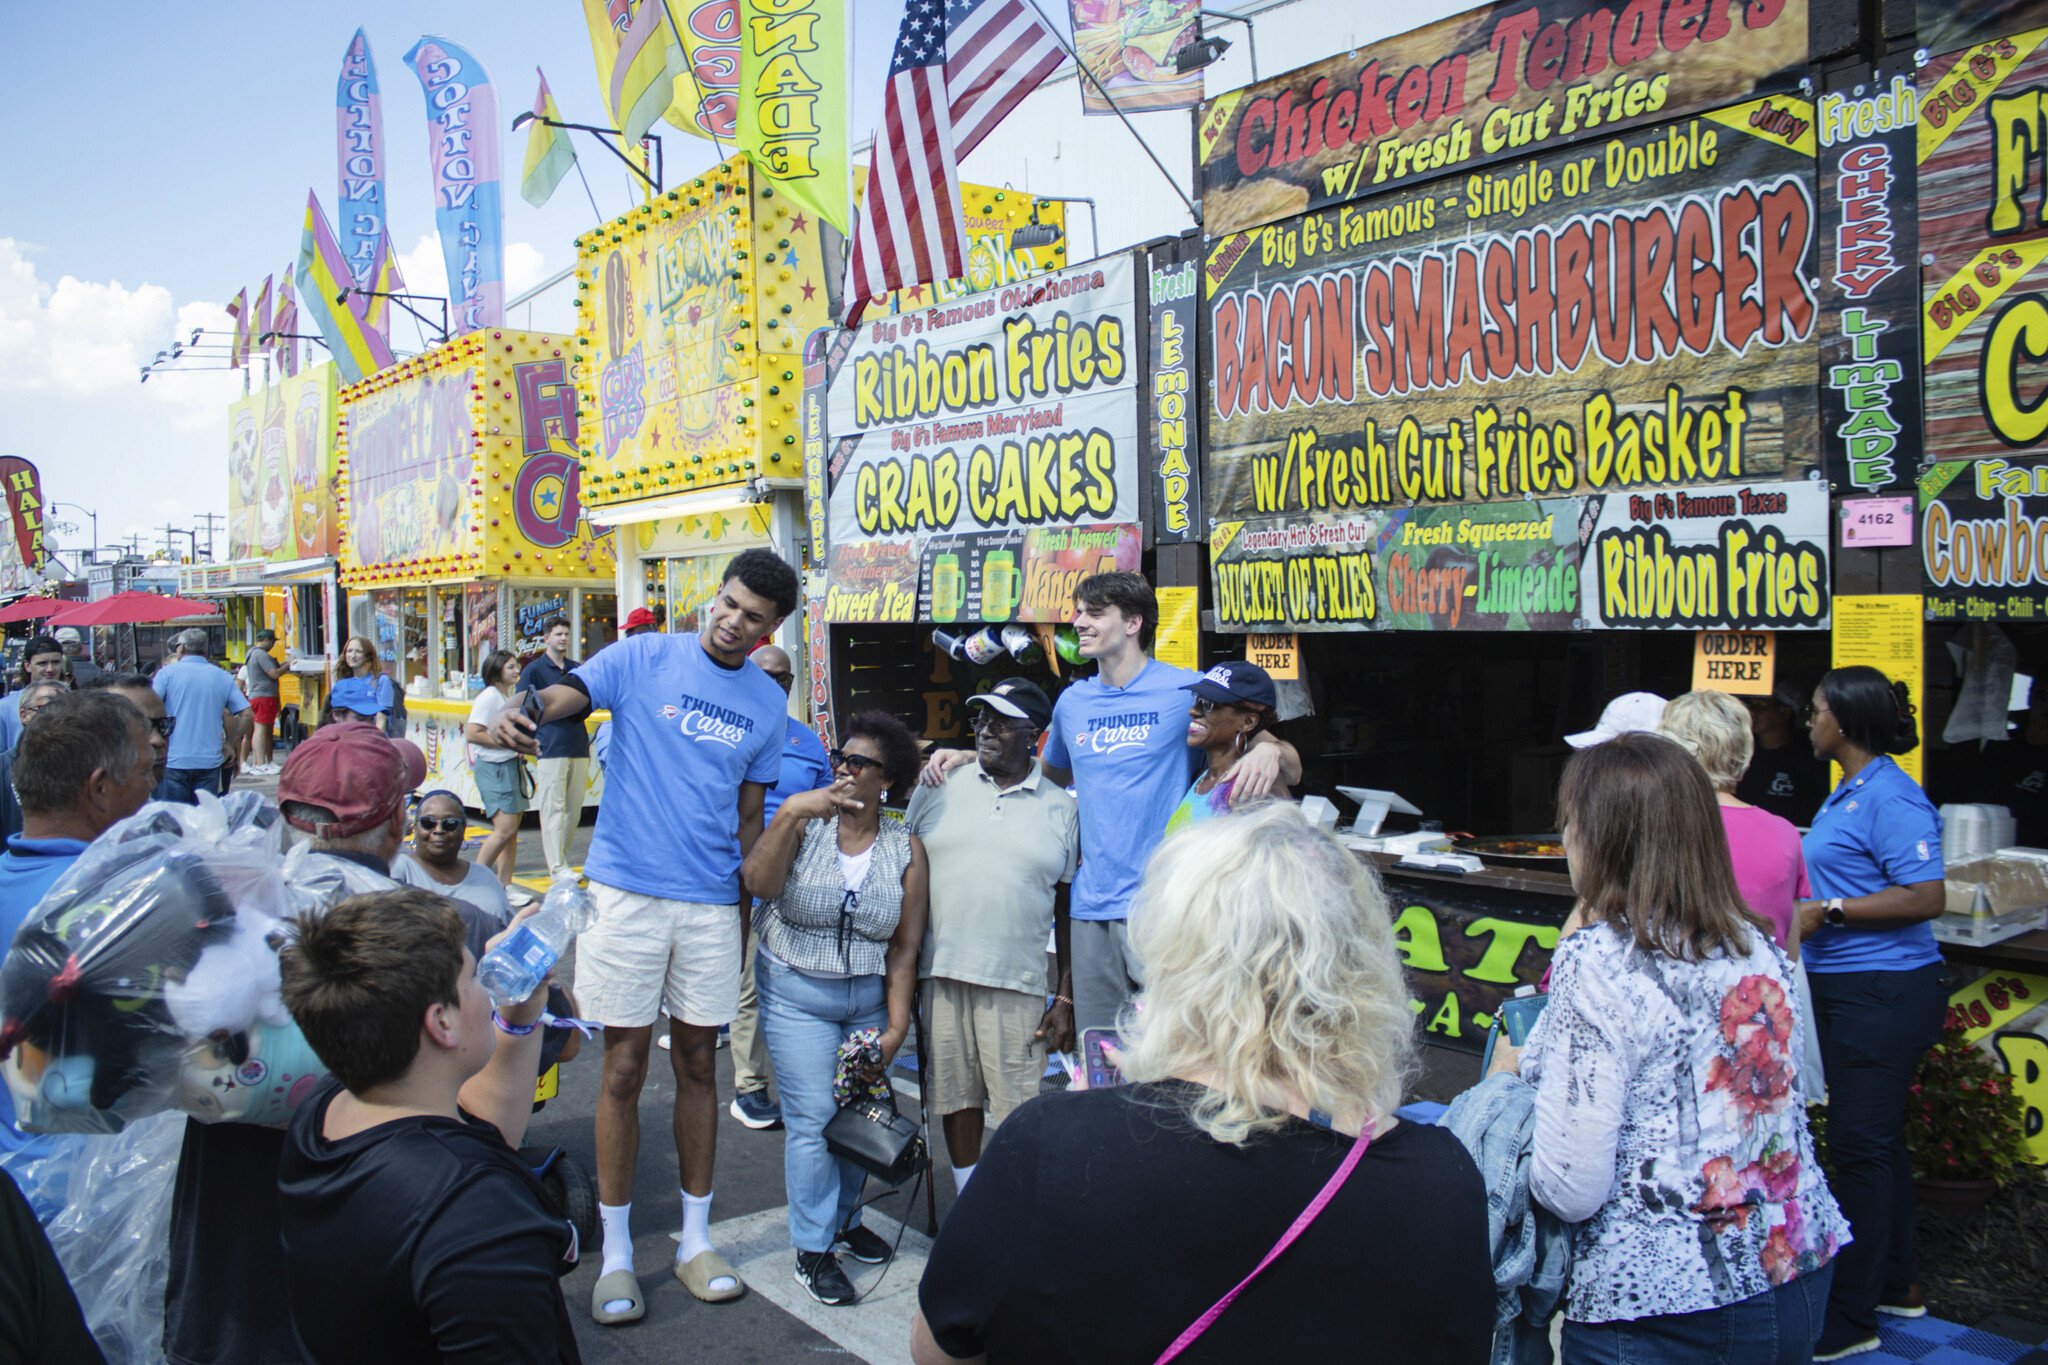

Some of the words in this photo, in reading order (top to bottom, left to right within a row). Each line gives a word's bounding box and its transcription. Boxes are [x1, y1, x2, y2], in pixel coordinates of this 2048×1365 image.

[1236, 53, 1468, 177] Chicken
[1487, 0, 1786, 102] Tenders
[1922, 79, 1976, 129] Big
[1969, 38, 2018, 81] G's
[1203, 121, 1219, 144] Big
[1214, 106, 1227, 127] G's
[1322, 146, 1370, 199] w/
[1372, 117, 1472, 184] Fresh
[1481, 98, 1554, 153] Cut
[1559, 71, 1670, 135] Fries
[1750, 100, 1809, 144] Juicy
[1818, 76, 1917, 148] Fresh
[1261, 225, 1297, 269] Big
[1302, 214, 1333, 257] G's
[1339, 199, 1435, 250] Famous
[1466, 160, 1554, 219] Single
[1562, 157, 1596, 197] or
[1605, 120, 1718, 188] Double
[1832, 143, 1905, 299] CHERRY
[1206, 231, 1250, 284] Delicious
[872, 320, 897, 344] Big
[901, 314, 923, 338] G's
[927, 300, 996, 332] Famous
[1001, 269, 1105, 311] Oklahoma
[1152, 260, 1195, 306] Fresh
[1212, 268, 1356, 420] BACON
[1361, 174, 1818, 397] SMASHBURGER
[1928, 281, 1980, 331] Big
[1976, 249, 2023, 289] G's
[600, 340, 647, 410] CORN
[856, 341, 998, 427] Ribbon
[1004, 311, 1125, 402] Fries
[1829, 307, 1902, 487] LIMEADE
[602, 384, 646, 461] DOGS
[891, 428, 911, 451] Big
[914, 424, 931, 447] G's
[933, 419, 984, 443] Famous
[987, 403, 1063, 436] Maryland
[1155, 310, 1189, 533] LEMONADE
[1397, 415, 1466, 502] Cut
[1474, 403, 1576, 500] Fries
[1584, 383, 1748, 489] Basket
[806, 394, 825, 559] LEMONADE
[856, 447, 961, 535] CRAB
[967, 427, 1117, 529] CAKES
[1921, 476, 1943, 495] Big
[1936, 463, 1955, 481] G's
[1630, 494, 1653, 524] Big
[1654, 493, 1675, 519] G's
[1677, 491, 1736, 519] Famous
[1738, 488, 1787, 515] Texas
[1858, 513, 1894, 525] 4162
[1037, 525, 1068, 551] Fresh
[1070, 523, 1120, 549] Brewed
[1212, 534, 1223, 552] Big
[1220, 526, 1232, 542] G's
[1242, 528, 1290, 553] Legendary
[1290, 526, 1308, 546] Hot
[1309, 527, 1318, 546] &
[1318, 524, 1345, 545] Fresh
[1348, 521, 1367, 543] Cut
[1402, 521, 1452, 546] Fresh
[1456, 514, 1553, 550] Squeezed
[846, 563, 896, 580] Southern
[1217, 559, 1286, 625] BUCKET
[1288, 556, 1313, 623] OF
[1315, 551, 1377, 622] FRIES
[1387, 549, 1578, 628] Cherry-Limeade
[1602, 531, 1719, 621] Ribbon
[1724, 526, 1821, 620] Fries
[518, 597, 566, 627] FUNNEL
[824, 585, 879, 622] Sweet
[880, 582, 915, 622] Tea
[1927, 596, 1956, 617] Meat
[1966, 596, 1997, 621] Chips
[2007, 596, 2033, 617] Chili
[809, 599, 827, 705] MANGO
[1252, 633, 1294, 650] ORDER
[1256, 653, 1291, 669] HERE
[1703, 634, 1768, 657] ORDER
[1707, 660, 1762, 681] HERE
[680, 693, 755, 734] THUNDER
[680, 709, 747, 744] Cares
[1088, 711, 1159, 732] THUNDER
[1092, 723, 1151, 753] Cares
[1984, 976, 2030, 1011] G's
